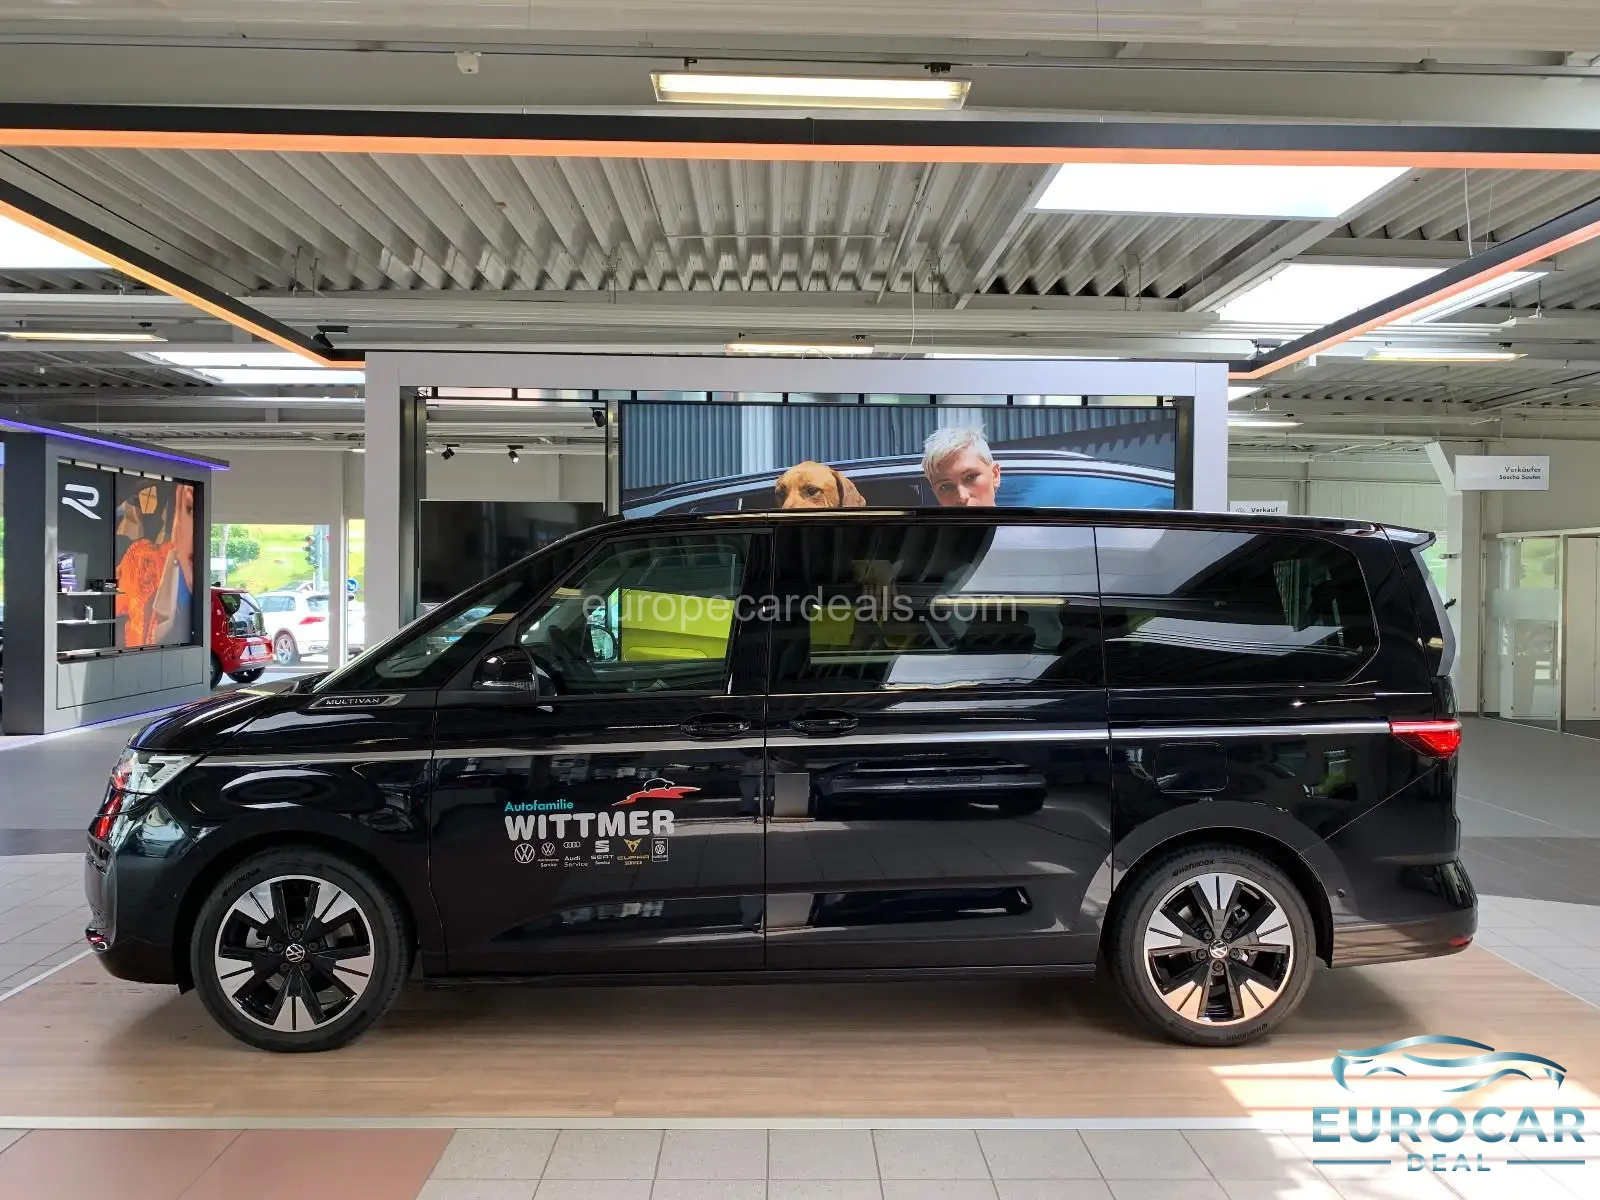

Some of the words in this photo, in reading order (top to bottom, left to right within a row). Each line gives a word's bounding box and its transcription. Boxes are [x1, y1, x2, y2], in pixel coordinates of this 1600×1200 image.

[1504, 465, 1541, 473] Verkäufer
[326, 697, 380, 705] MULTIVAN
[504, 799, 574, 812] Autofamilie
[504, 809, 675, 841] WITTMER
